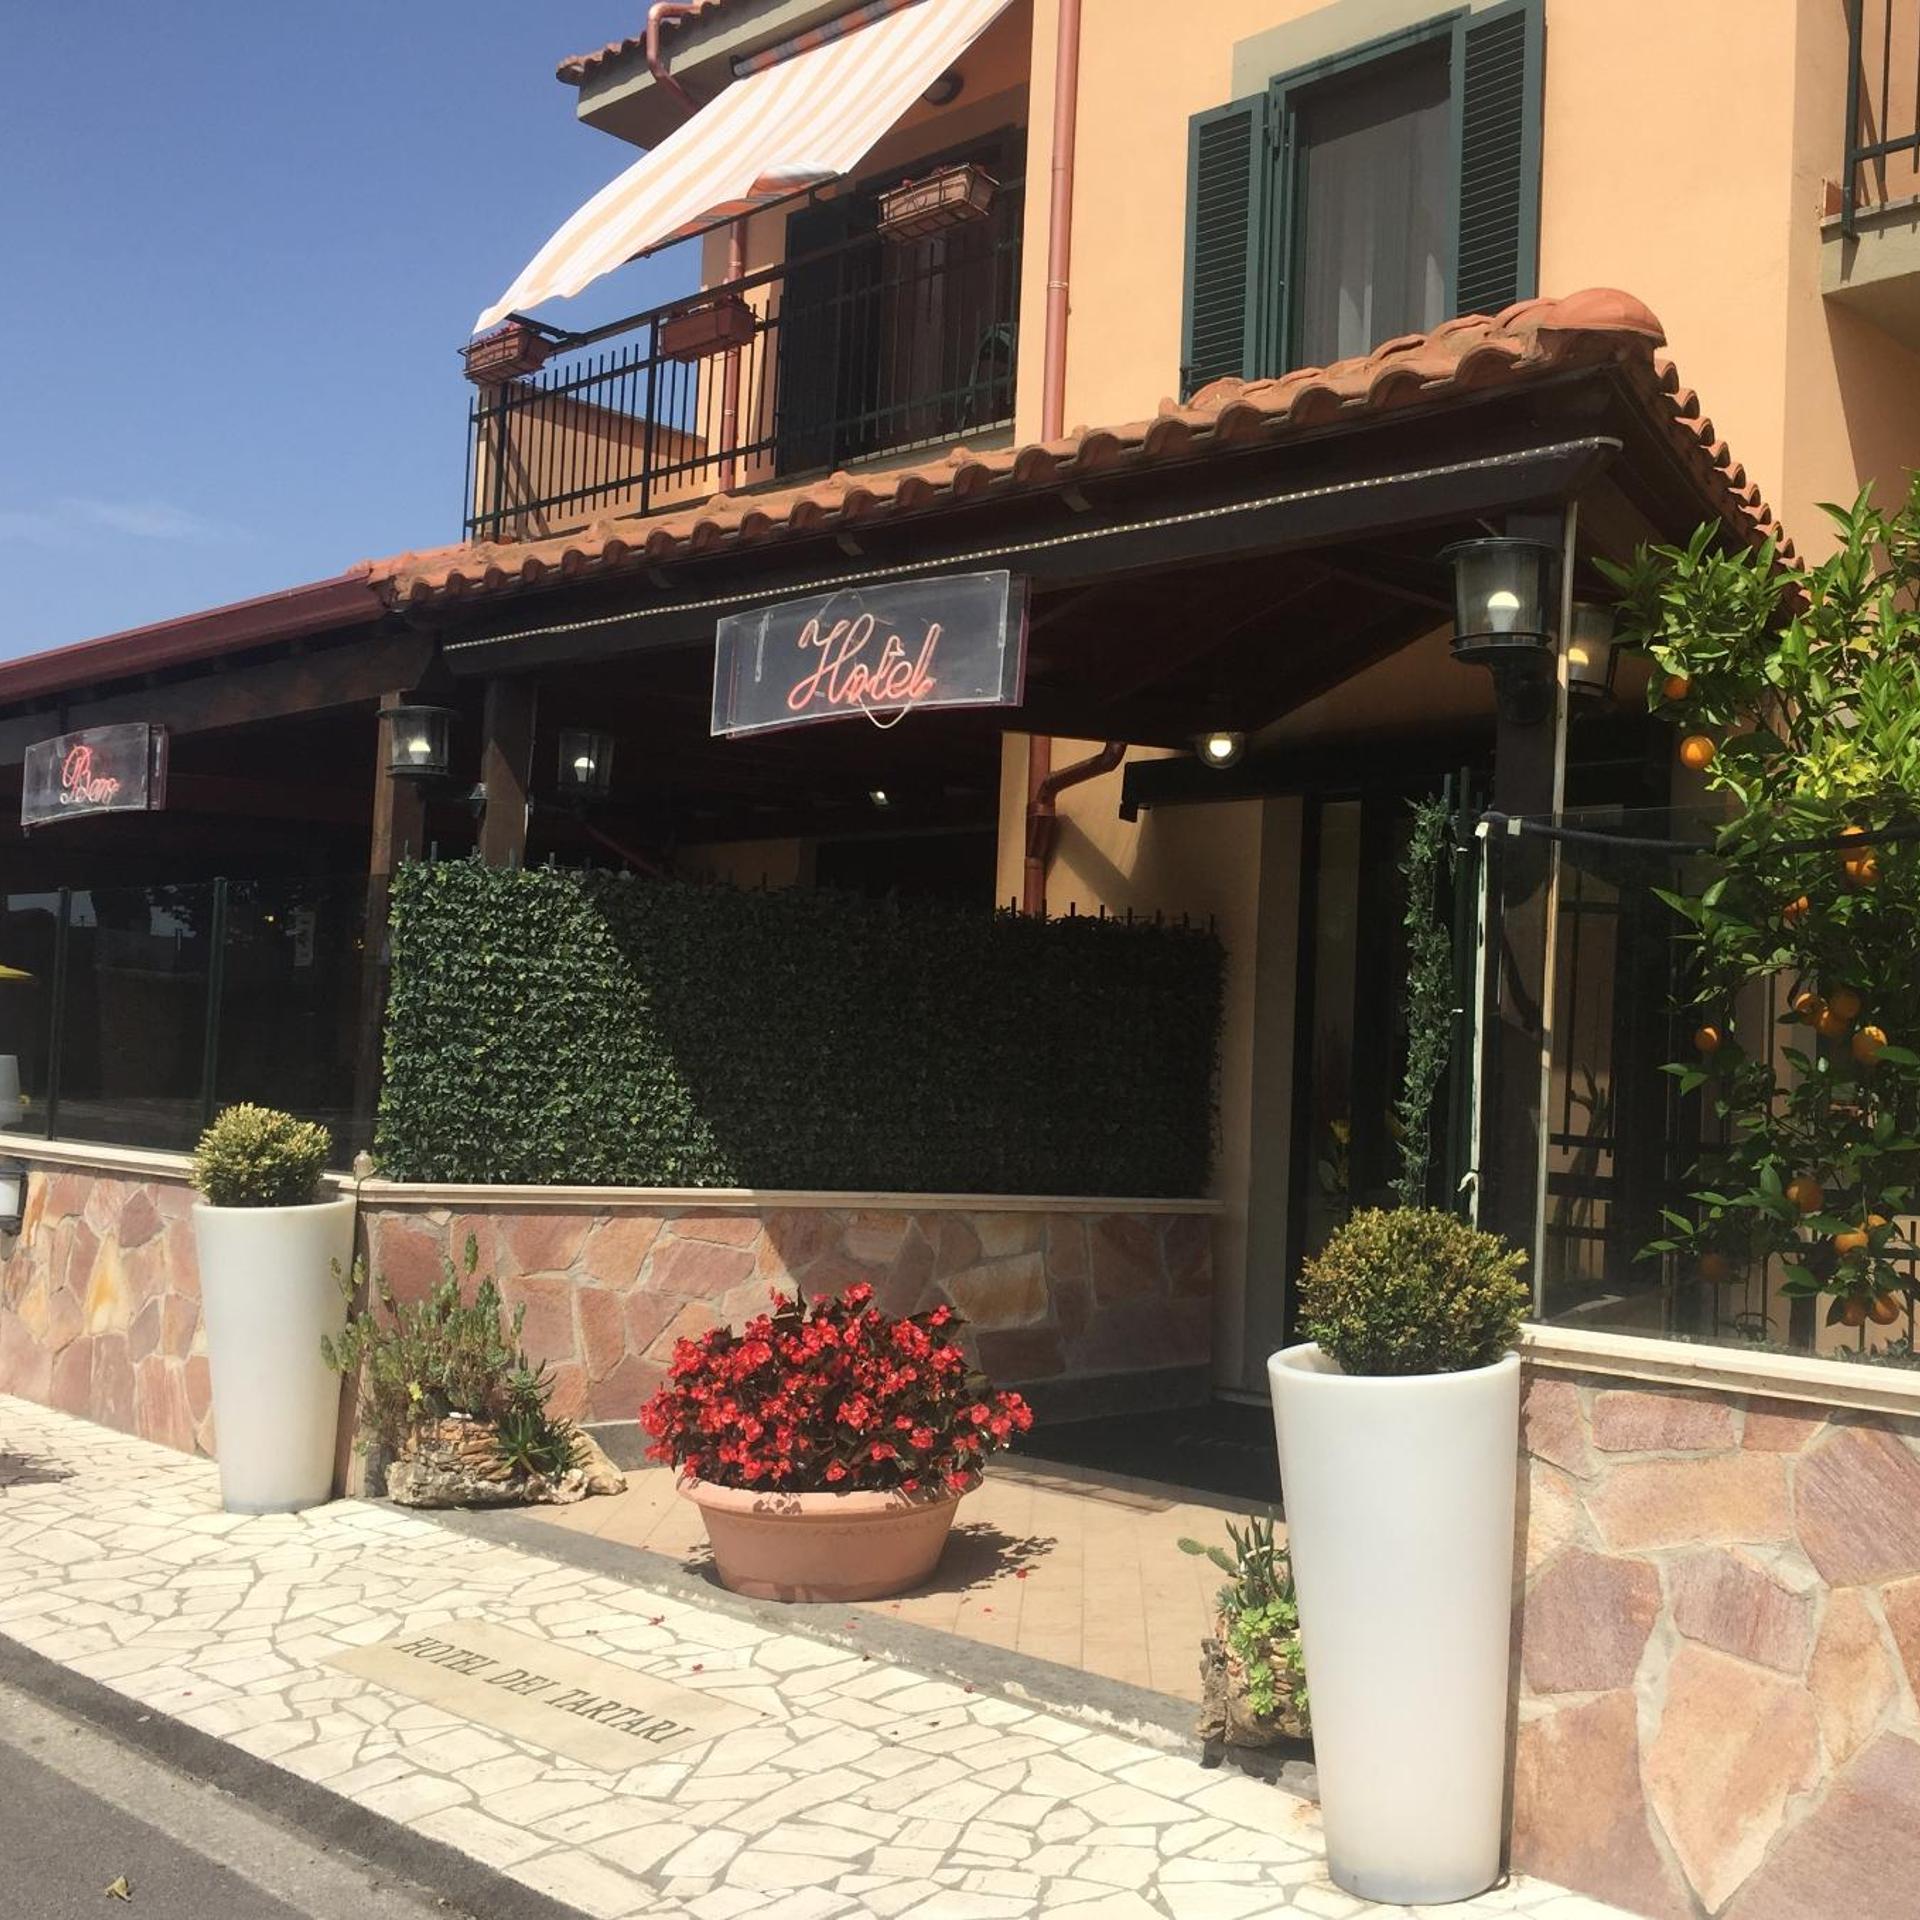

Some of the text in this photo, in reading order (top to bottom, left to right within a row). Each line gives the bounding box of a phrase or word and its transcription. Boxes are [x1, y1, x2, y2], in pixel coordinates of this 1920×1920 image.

[788, 613, 943, 711] Hotel
[392, 1636, 696, 1744] HOTEL DEI TARTARI
